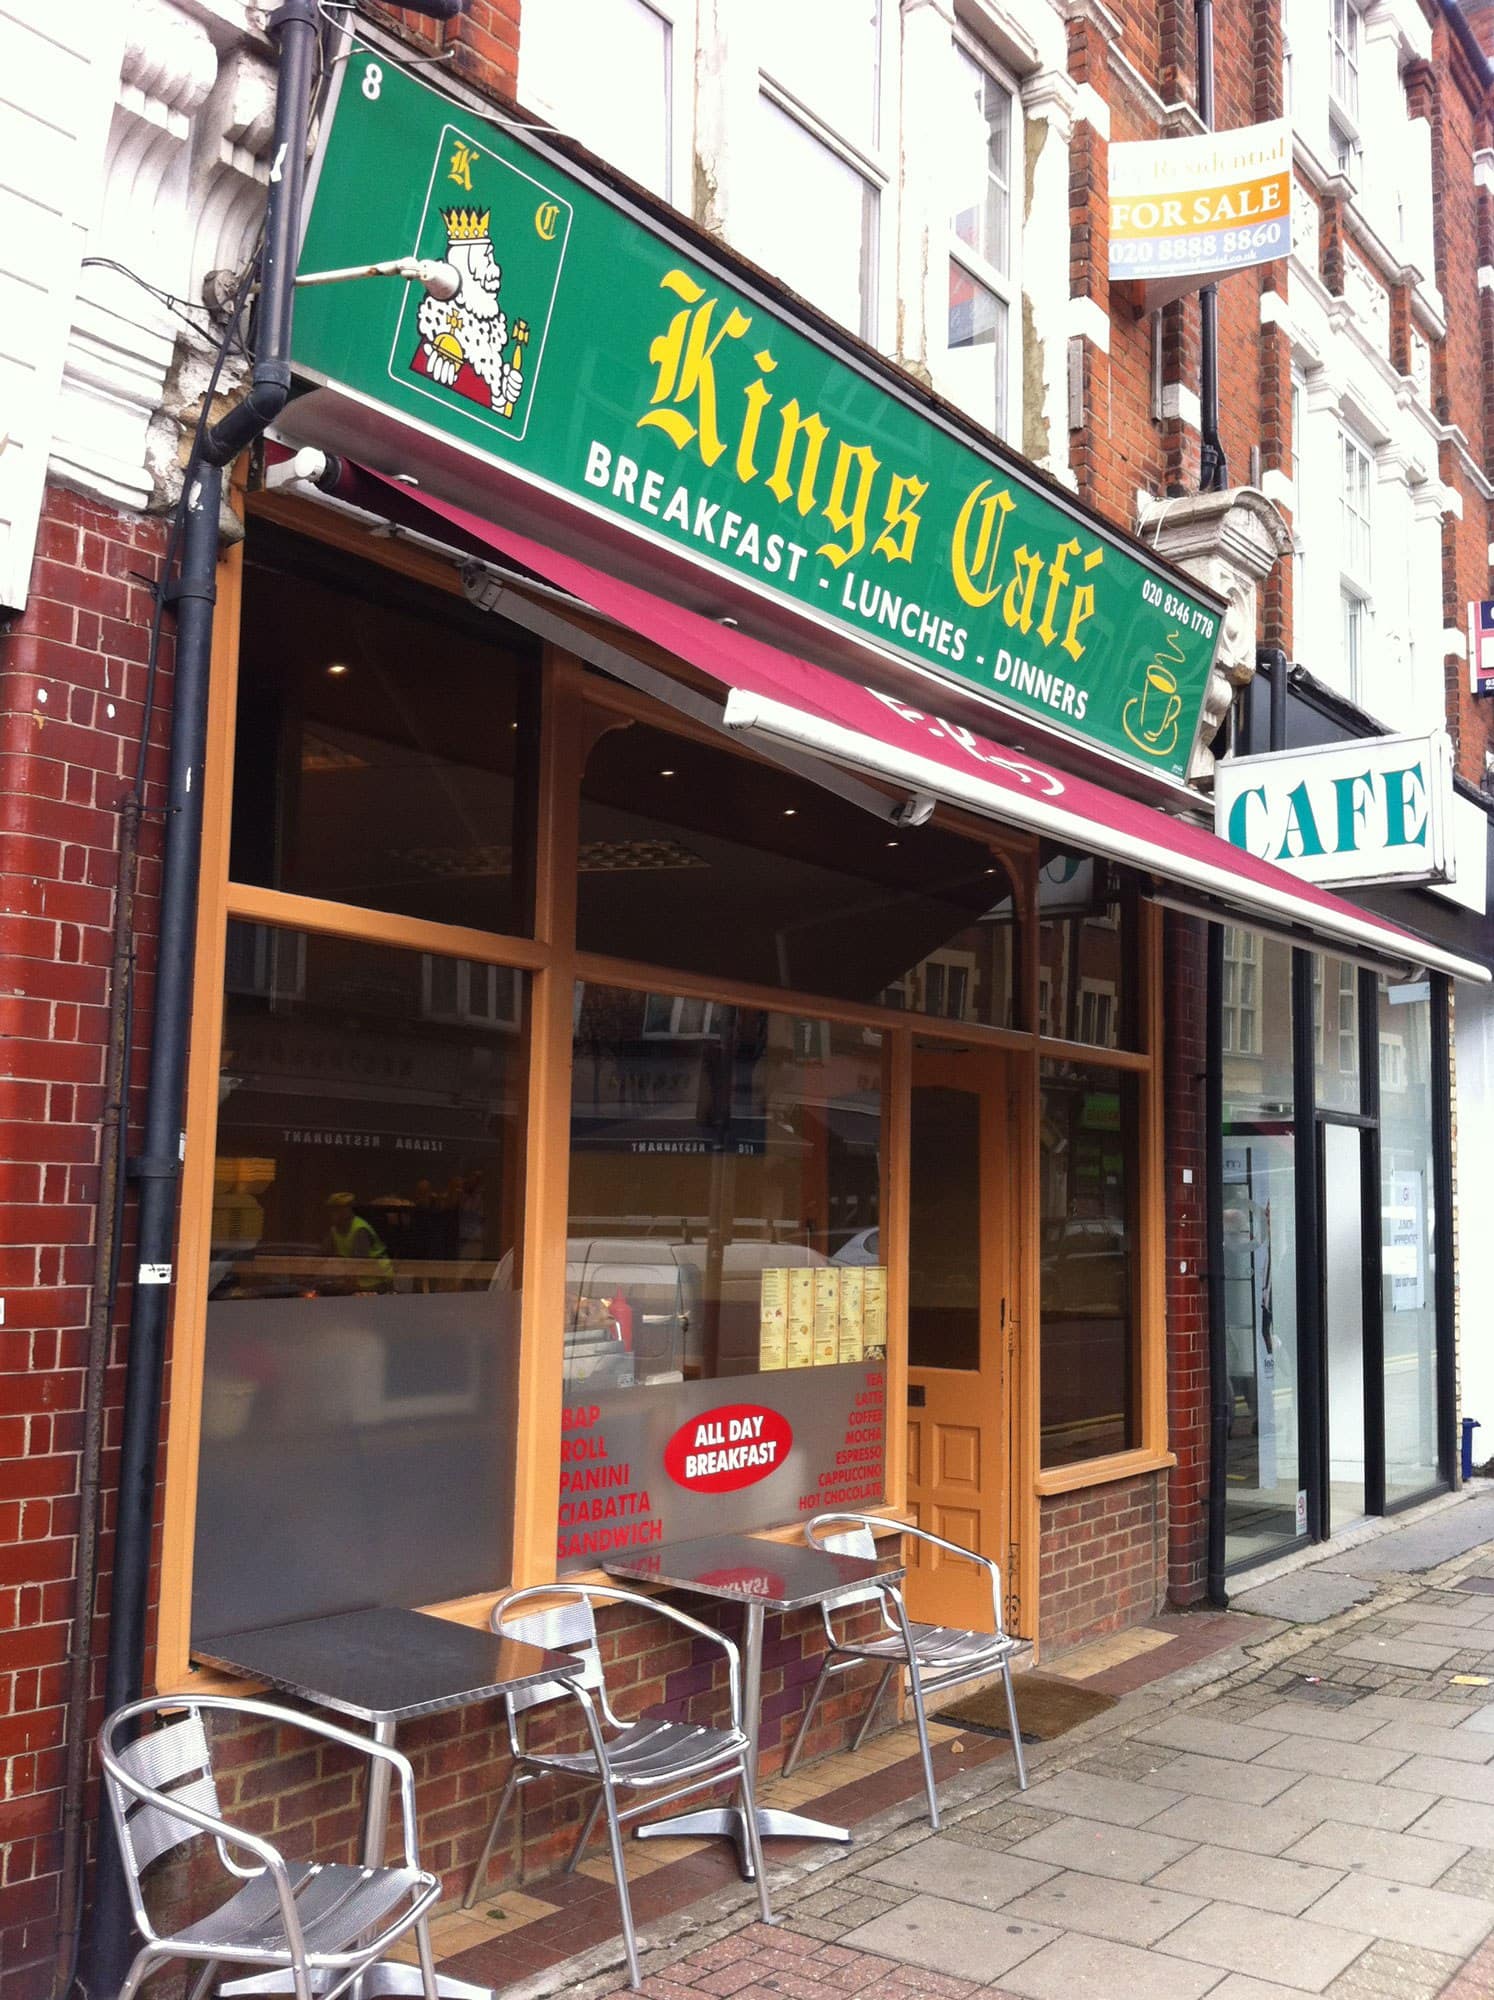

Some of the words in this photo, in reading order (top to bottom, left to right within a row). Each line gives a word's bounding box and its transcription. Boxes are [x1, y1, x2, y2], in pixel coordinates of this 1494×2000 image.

[362, 63, 383, 100] 8
[449, 141, 480, 191] K
[1111, 200, 1186, 231] FOR
[1192, 183, 1282, 225] SALE
[1110, 241, 1153, 264] 020
[1223, 222, 1282, 253] 8860
[636, 269, 930, 570] Kings
[951, 479, 1104, 663] Café
[584, 440, 808, 583] BREAKFAST
[842, 571, 968, 662] LUNCHES
[994, 649, 1089, 721] DINNERS
[1142, 578, 1162, 606] 020
[1163, 594, 1190, 625] 8346
[1190, 610, 1214, 639] 1778
[1228, 761, 1428, 861] CAFE
[865, 1372, 883, 1388] TEA
[855, 1390, 883, 1407] LATTE
[562, 1405, 601, 1432] BAP
[694, 1422, 725, 1448] ALL
[729, 1415, 764, 1443] DAY
[847, 1408, 883, 1426] COFFEE
[561, 1436, 609, 1464] ROLL
[844, 1427, 882, 1445] MOCHA
[685, 1440, 777, 1479] BREAKFAST
[835, 1445, 883, 1466] ESPRESSO
[559, 1463, 631, 1496] PANINI
[817, 1463, 883, 1488] CAPPUCCINO
[558, 1490, 652, 1528] CIABATTA
[798, 1493, 821, 1512] HOT
[822, 1481, 883, 1507] CHOCOLATE
[556, 1518, 664, 1561] SANDWICH
